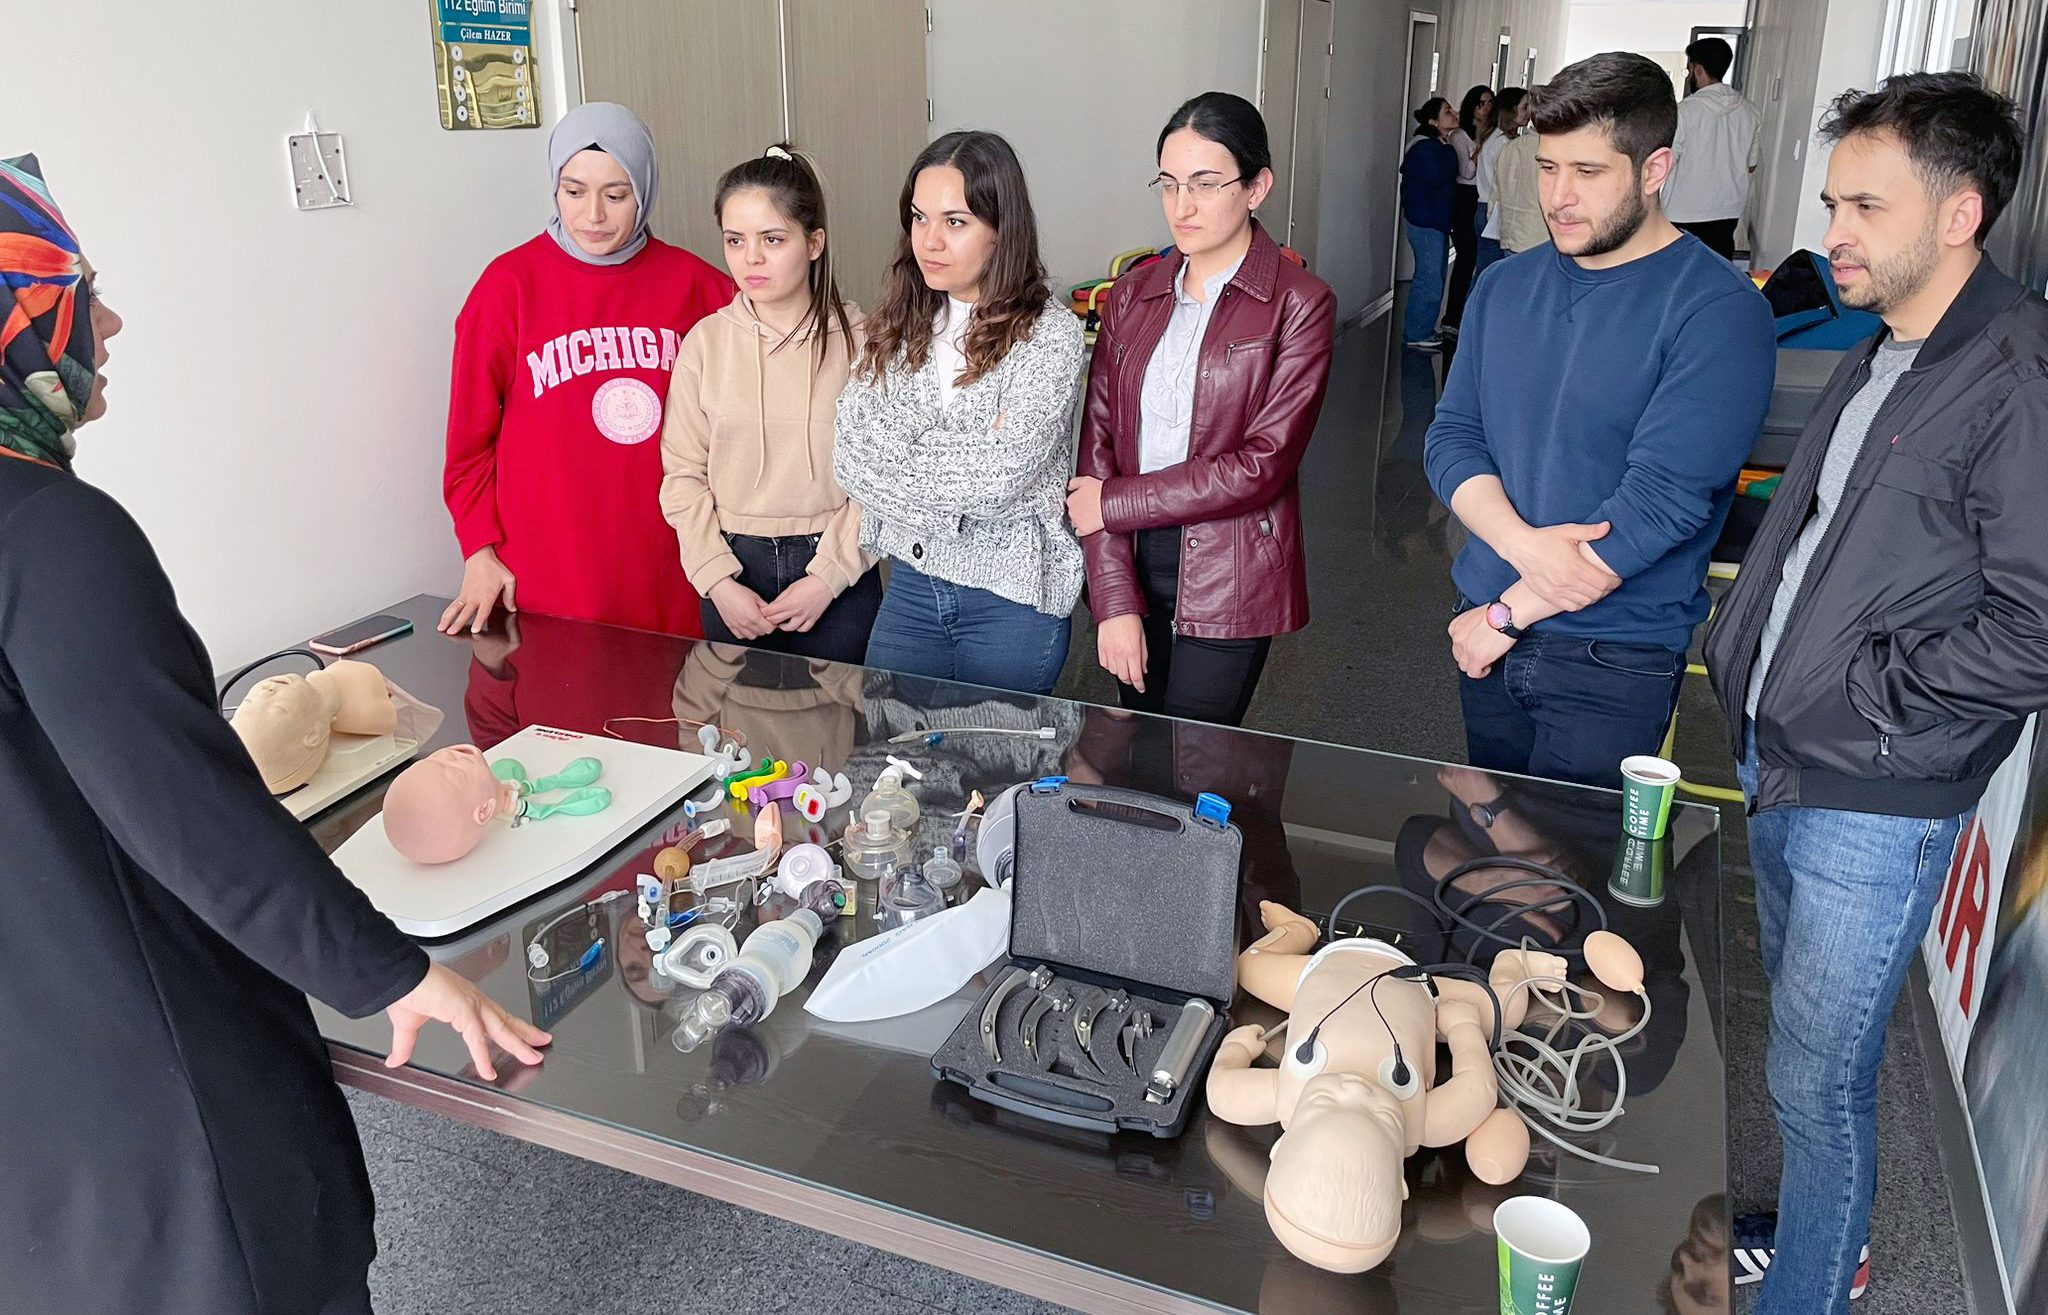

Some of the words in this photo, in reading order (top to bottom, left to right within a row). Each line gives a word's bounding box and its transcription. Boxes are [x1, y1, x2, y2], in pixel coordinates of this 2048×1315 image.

[499, 0, 526, 15] Birimi
[460, 28, 482, 41] Çilem
[484, 29, 511, 41] HAZER
[526, 327, 683, 399] MICHIGA
[1629, 788, 1639, 834] COFFEE
[1638, 809, 1649, 836] TIME
[1937, 815, 1990, 1020] IR
[1535, 1273, 1554, 1315] FFEE
